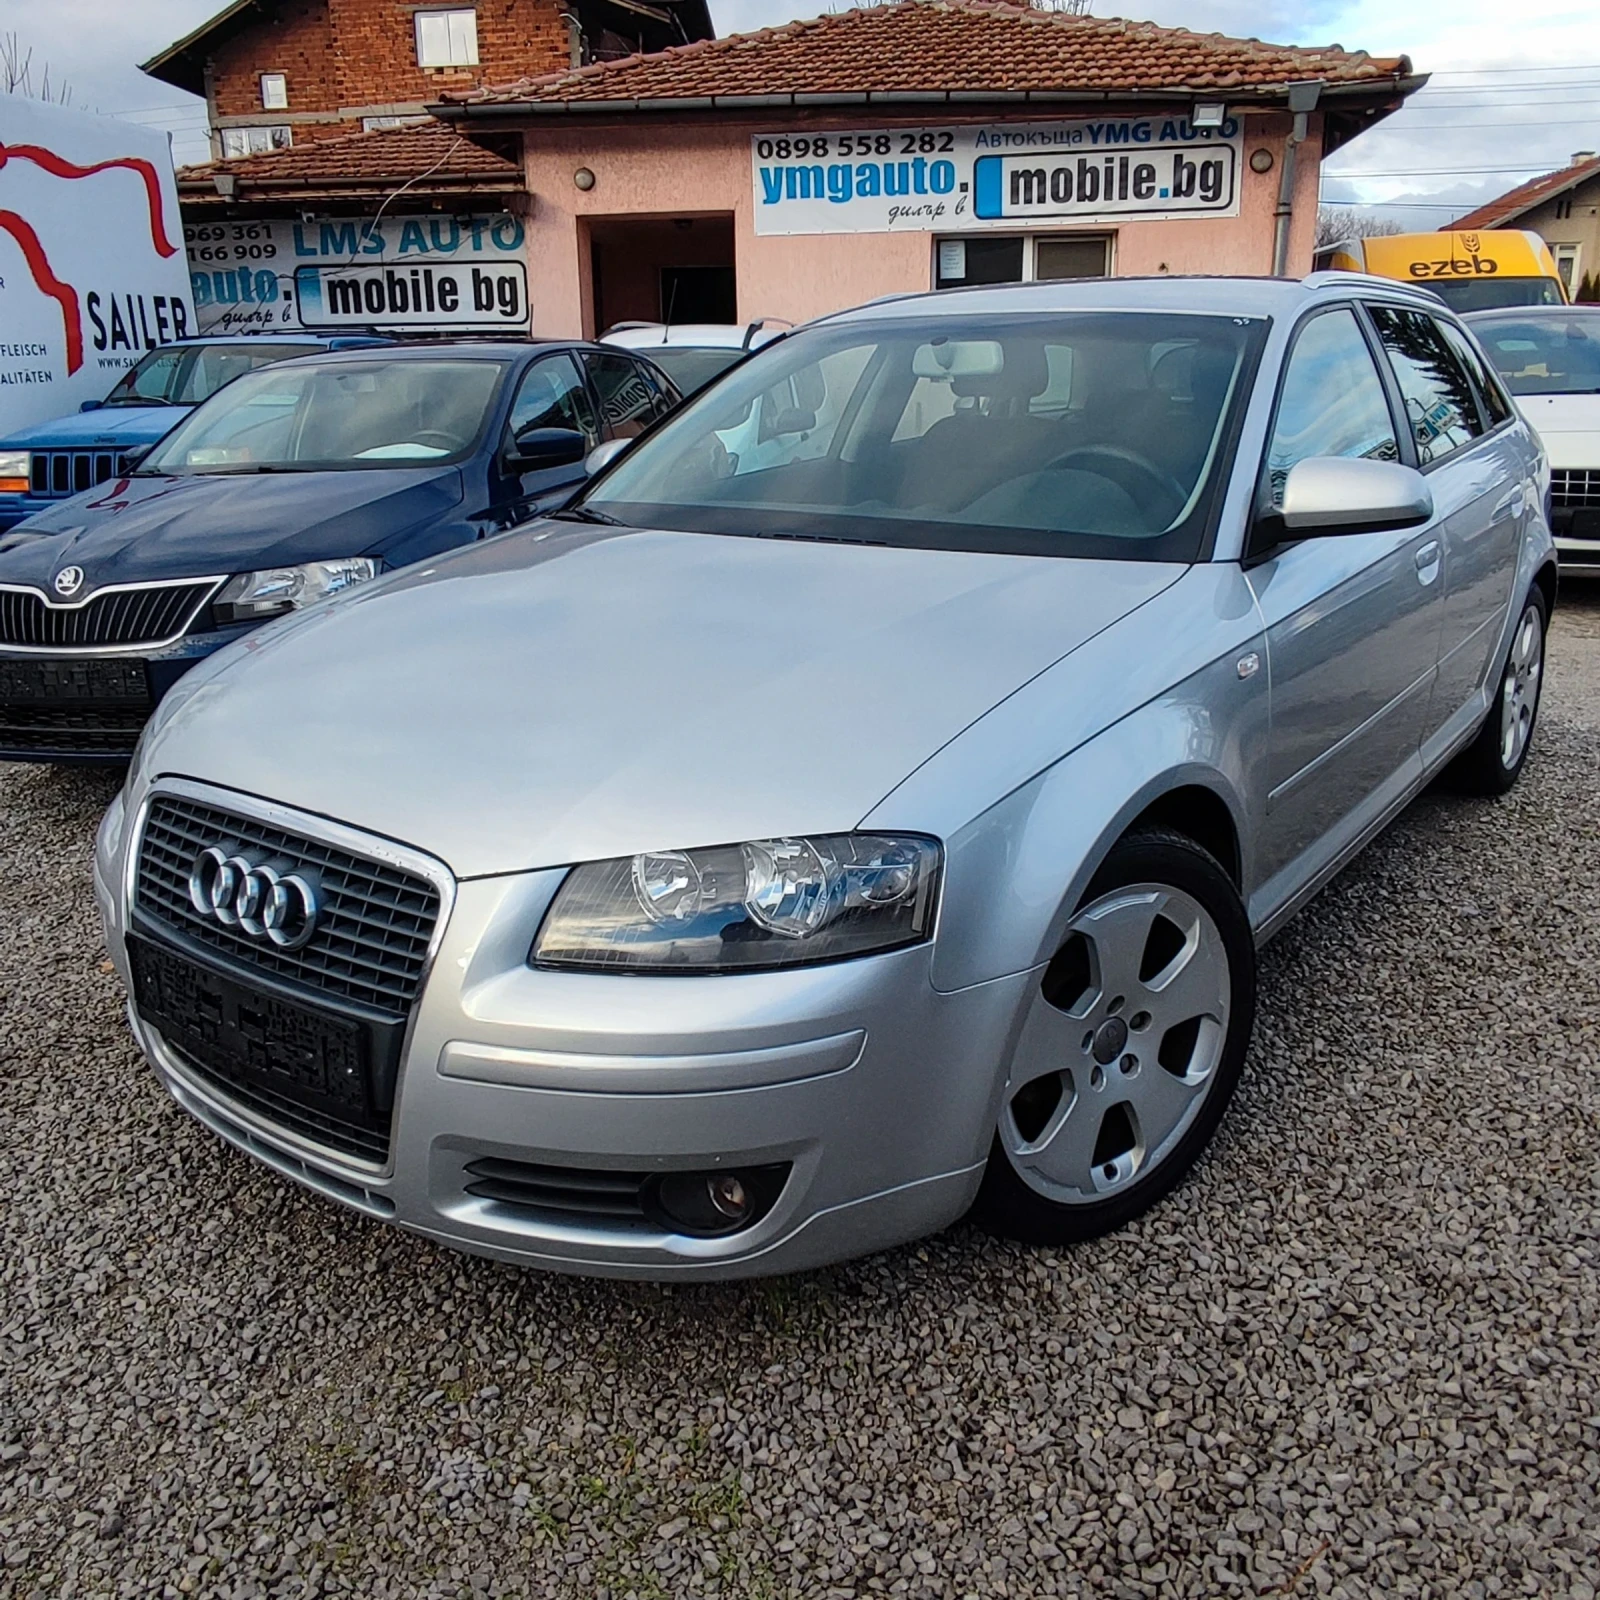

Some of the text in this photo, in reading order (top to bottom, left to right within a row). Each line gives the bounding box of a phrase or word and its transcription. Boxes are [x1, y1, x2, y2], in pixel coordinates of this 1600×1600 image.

[975, 128, 1082, 149] Автокъща
[1086, 121, 1151, 145] YMG
[757, 132, 954, 159] 0898 558 282
[1010, 153, 1224, 205] mobile.bg
[232, 225, 272, 240] 361
[293, 217, 525, 256] LMS AUTO
[234, 244, 277, 259] 909
[1409, 254, 1498, 278] ezeb
[87, 291, 187, 350] SAILER
